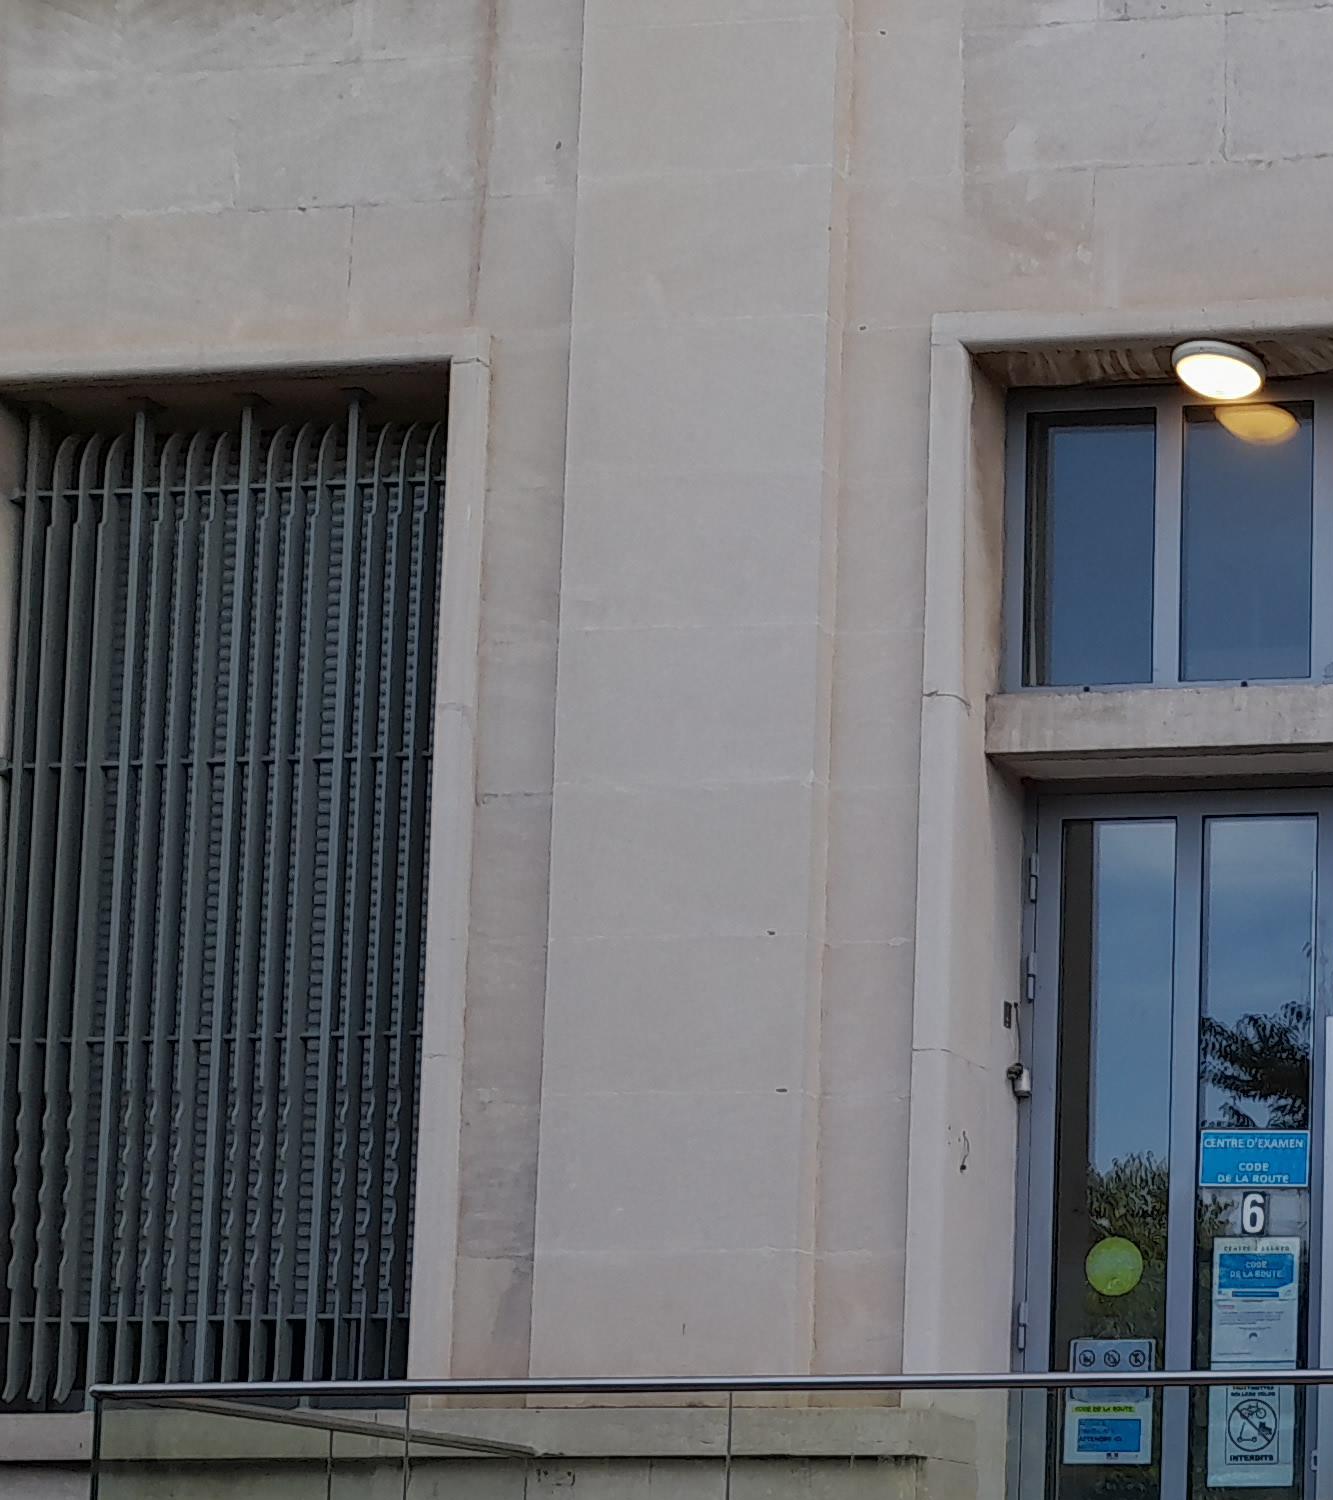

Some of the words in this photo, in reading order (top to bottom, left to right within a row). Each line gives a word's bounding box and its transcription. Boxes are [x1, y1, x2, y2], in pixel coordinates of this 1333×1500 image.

[1204, 1138, 1245, 1148] CENTRE
[1247, 1137, 1303, 1149] D'EXAMEN
[1239, 1162, 1269, 1172] CODE
[1217, 1174, 1232, 1183] DE
[1236, 1174, 1249, 1183] LA
[1252, 1174, 1289, 1183] ROUTE
[1242, 1193, 1265, 1234] 6
[1229, 1454, 1274, 1462] INTERDITS
